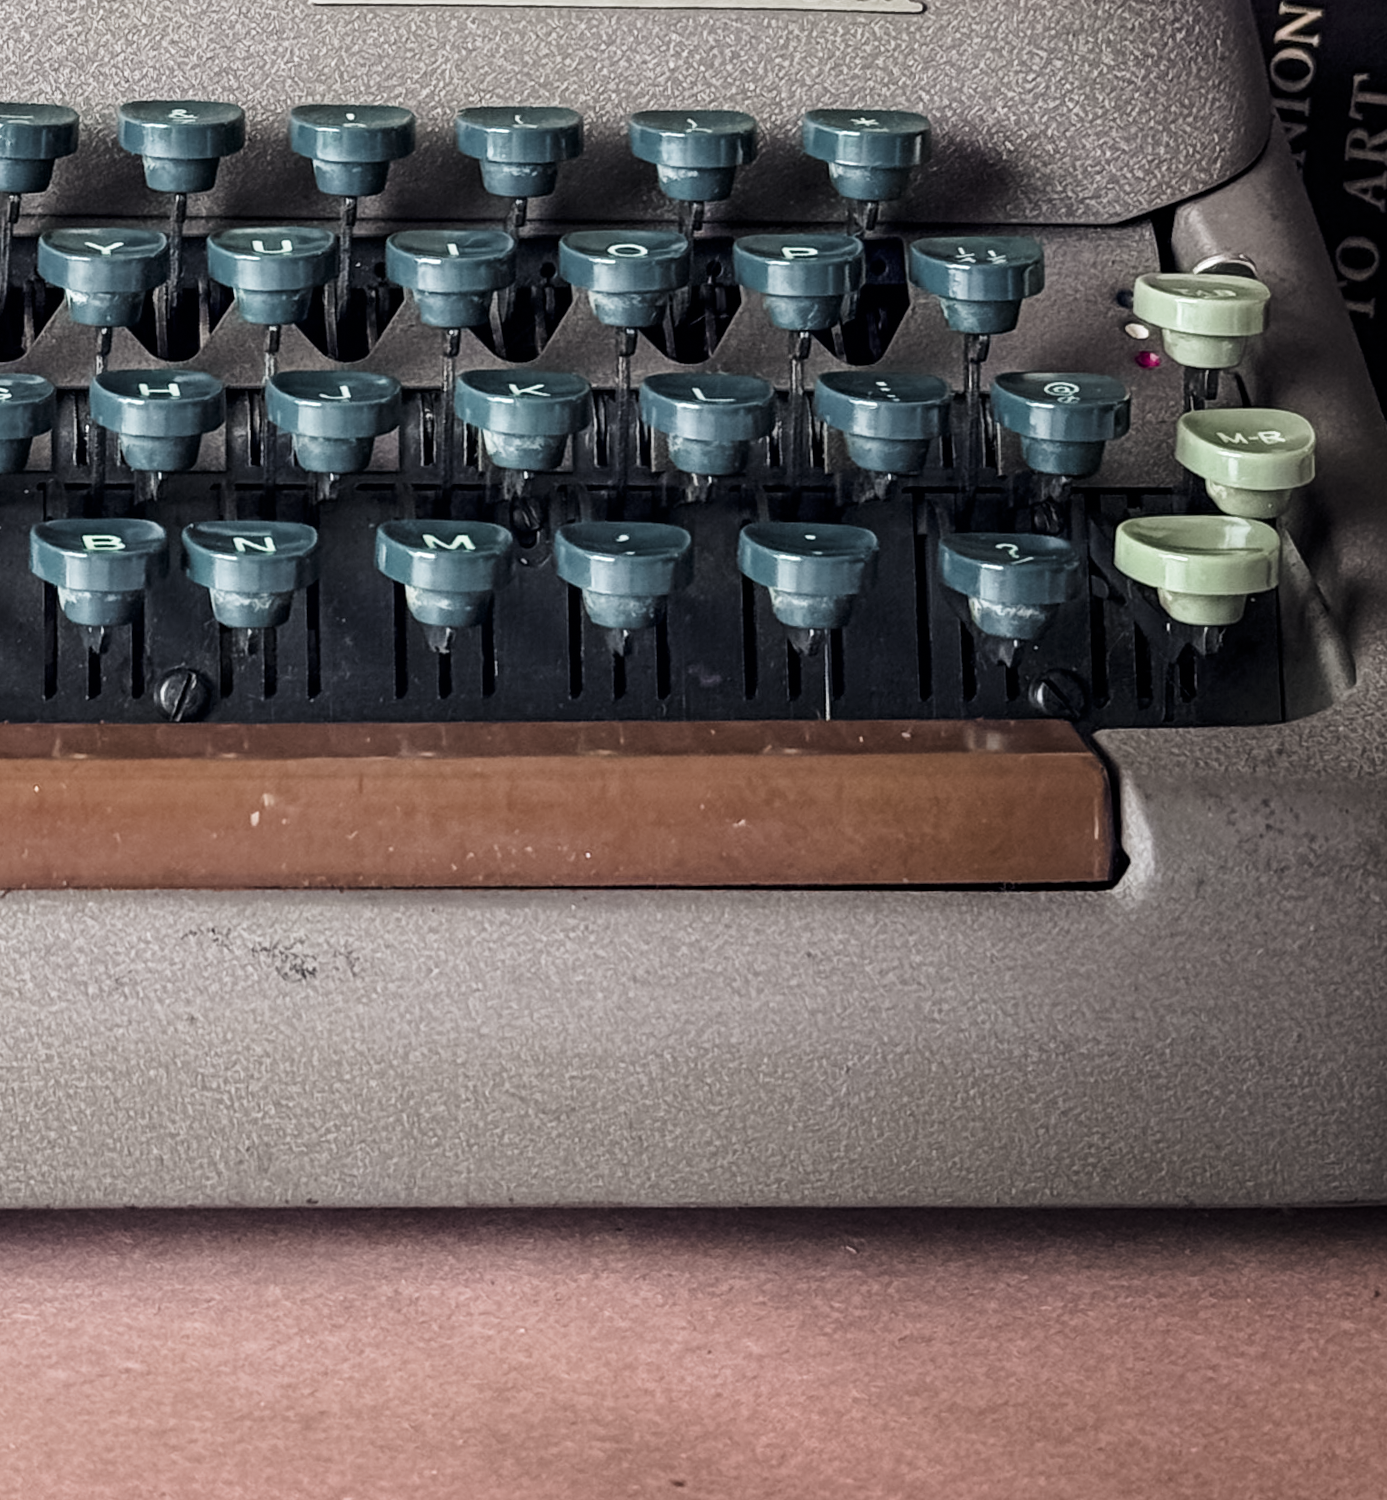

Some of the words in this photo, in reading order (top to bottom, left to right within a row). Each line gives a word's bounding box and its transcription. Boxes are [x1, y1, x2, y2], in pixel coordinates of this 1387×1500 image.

[1343, 73, 1387, 213] ART
[85, 241, 124, 255] Y
[252, 239, 292, 254] U
[607, 243, 648, 258] O
[781, 246, 819, 260] P
[138, 382, 182, 398] H
[319, 384, 352, 400] J
[508, 383, 551, 398] K
[81, 534, 126, 552] B
[232, 536, 277, 553] N
[422, 534, 477, 551] M
